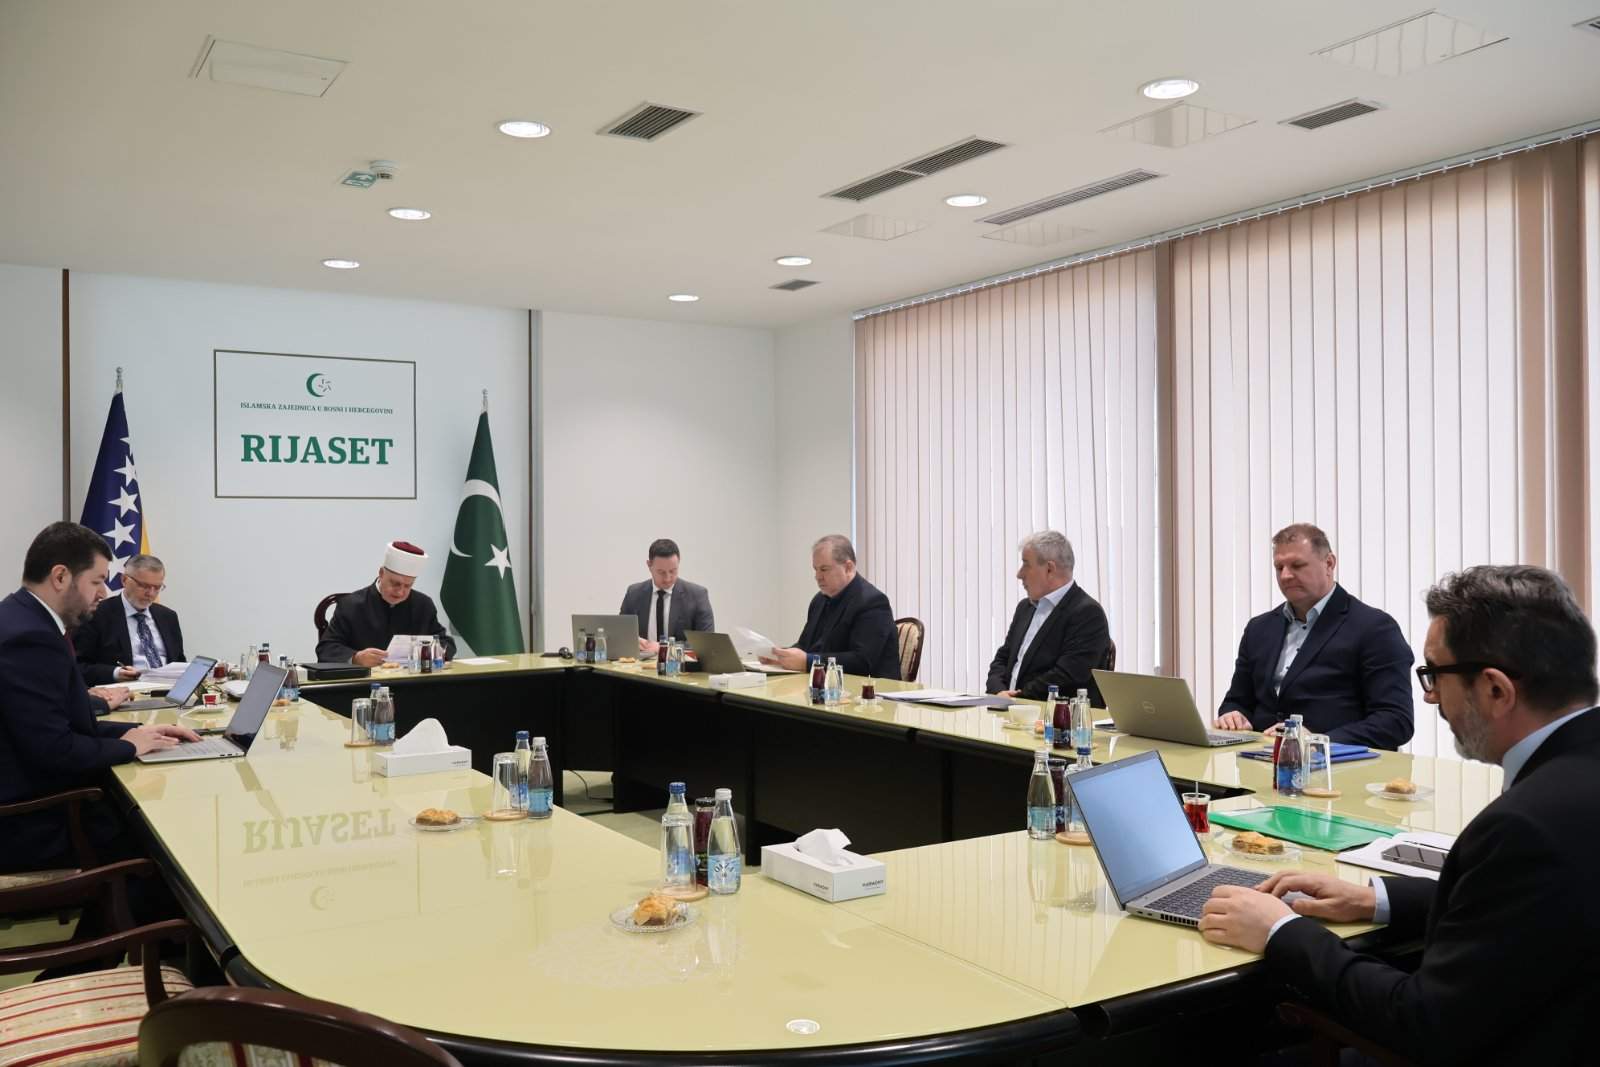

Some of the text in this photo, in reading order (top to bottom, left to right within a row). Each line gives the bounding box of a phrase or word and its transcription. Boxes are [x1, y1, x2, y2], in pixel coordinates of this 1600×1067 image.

[240, 402, 276, 410] ISLAMSKA
[278, 403, 316, 412] ZAJEDNICA
[349, 407, 393, 415] HERCEGOVINI
[240, 434, 394, 465] RIJASET
